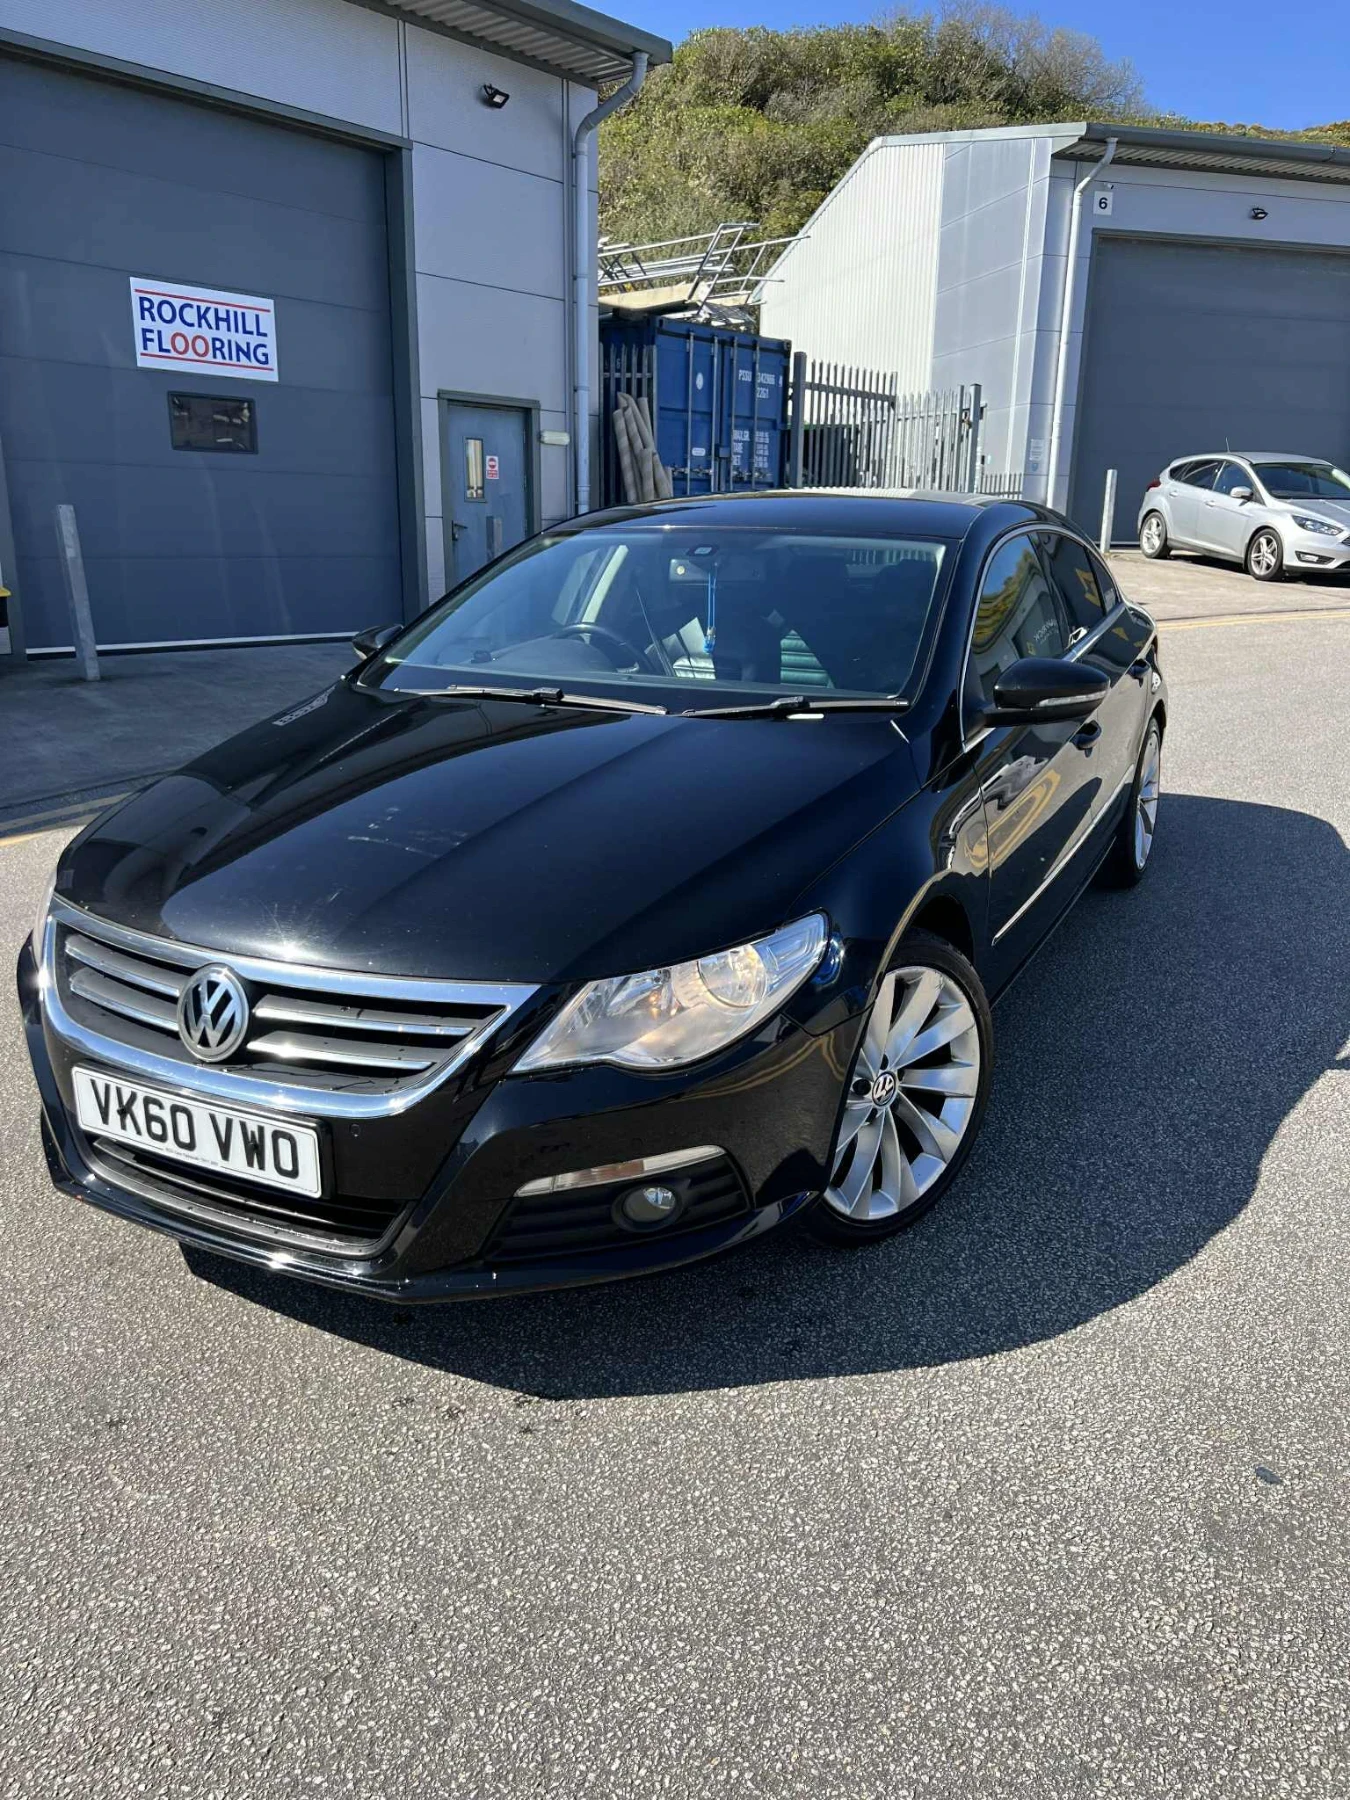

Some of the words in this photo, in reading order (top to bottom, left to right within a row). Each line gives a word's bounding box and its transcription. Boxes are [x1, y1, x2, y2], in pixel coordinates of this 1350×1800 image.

[1098, 197, 1108, 209] 6
[138, 296, 268, 337] ROCKHILL
[141, 327, 269, 365] FLOORING
[90, 1078, 197, 1152] VK60
[208, 1112, 299, 1179] VWO
